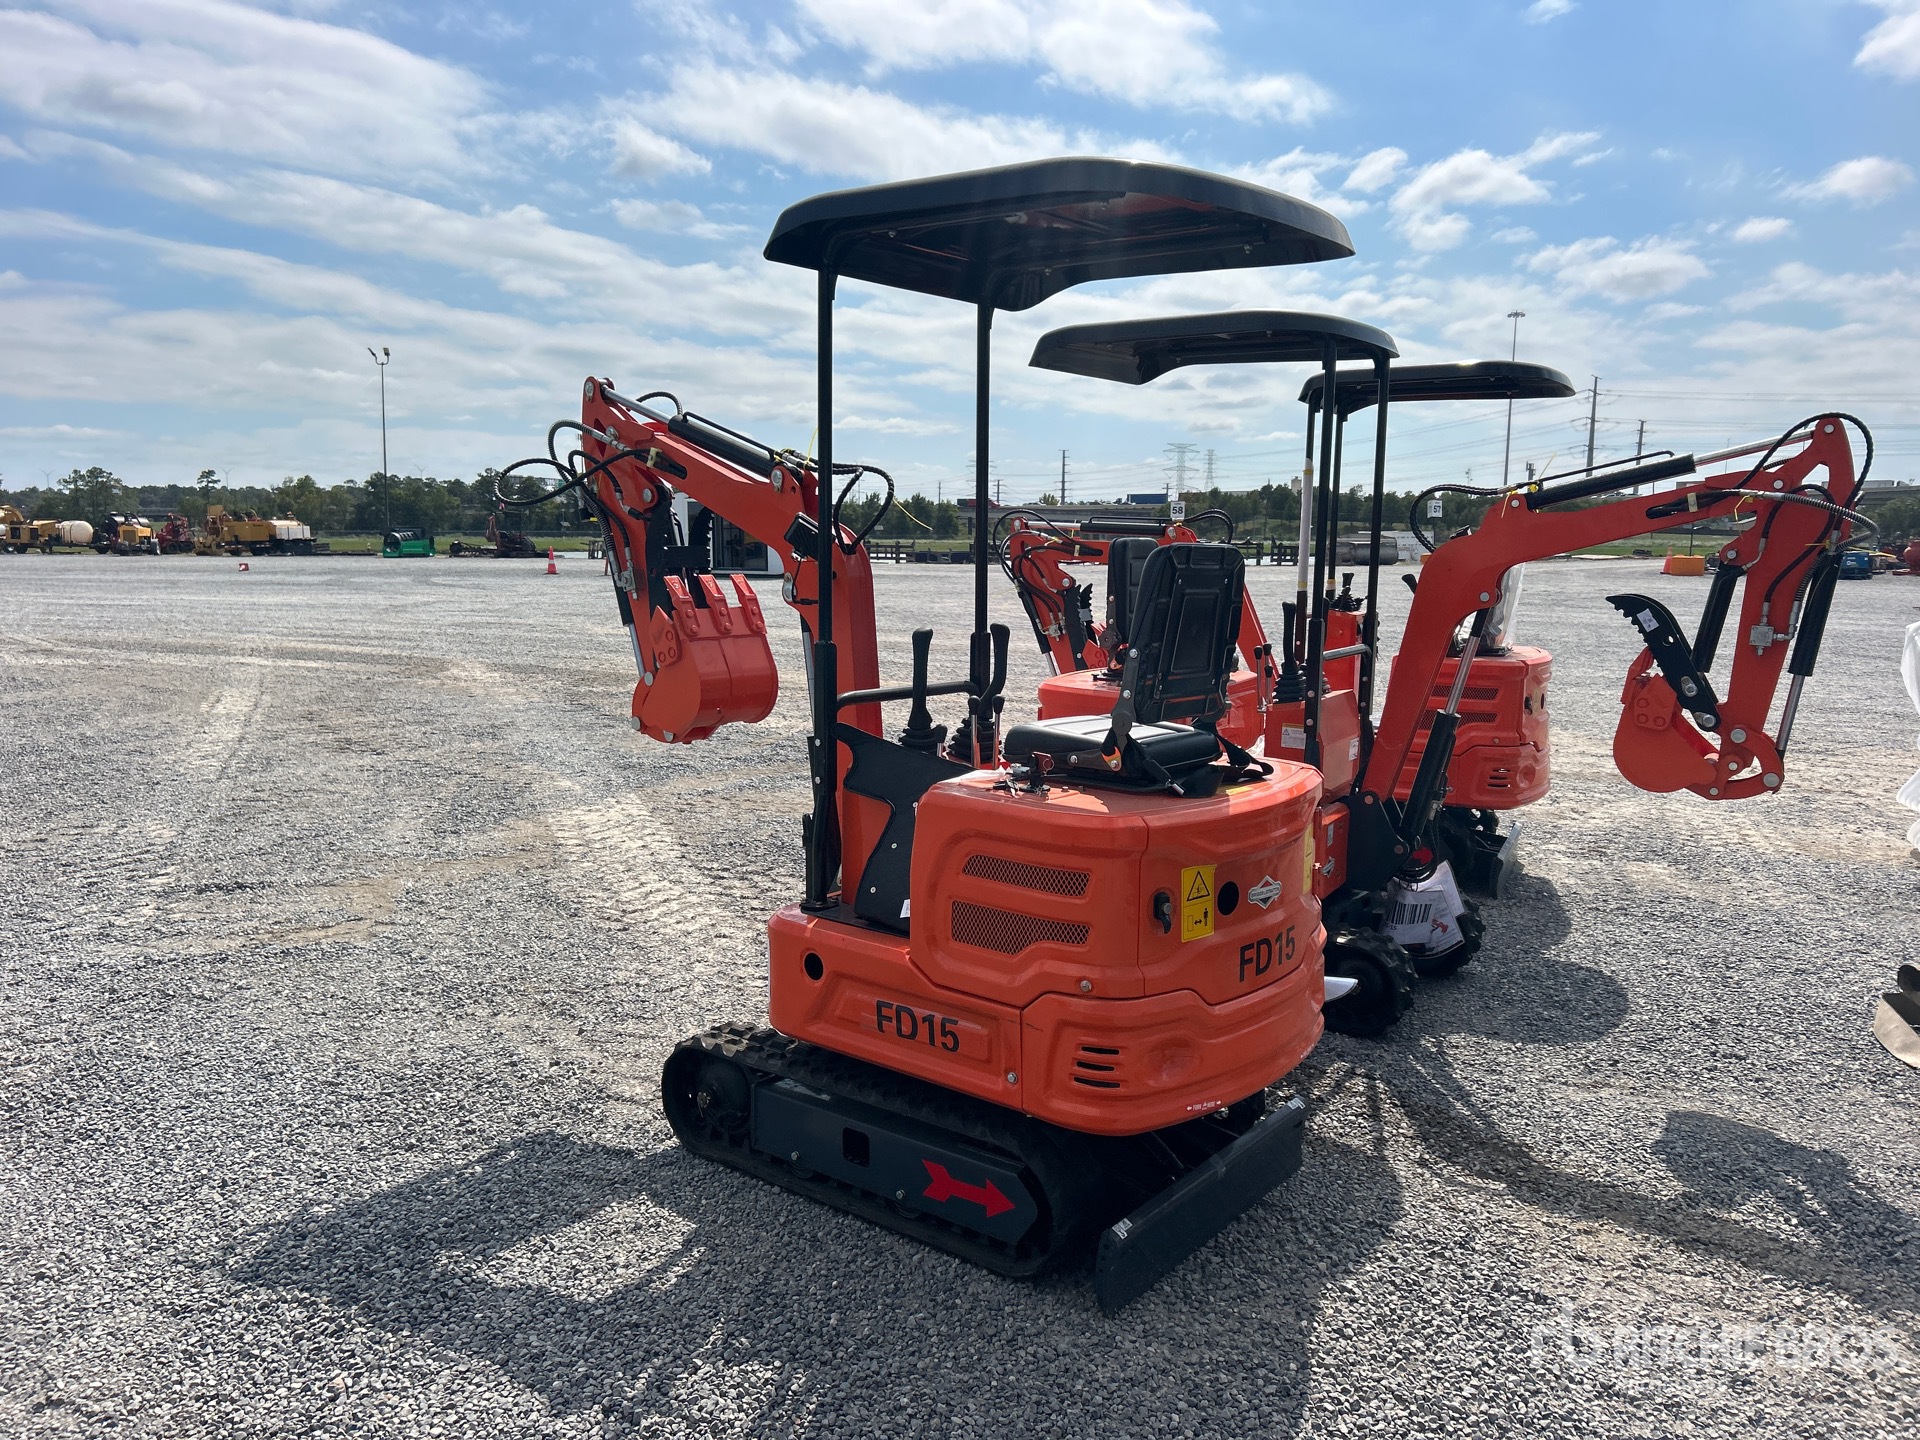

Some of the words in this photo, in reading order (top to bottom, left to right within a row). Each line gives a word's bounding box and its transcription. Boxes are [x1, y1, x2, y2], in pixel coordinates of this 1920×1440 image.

[1172, 506, 1184, 515] 58
[1433, 505, 1442, 514] 57
[1239, 925, 1296, 983] FD15
[876, 1000, 960, 1053] FD15
